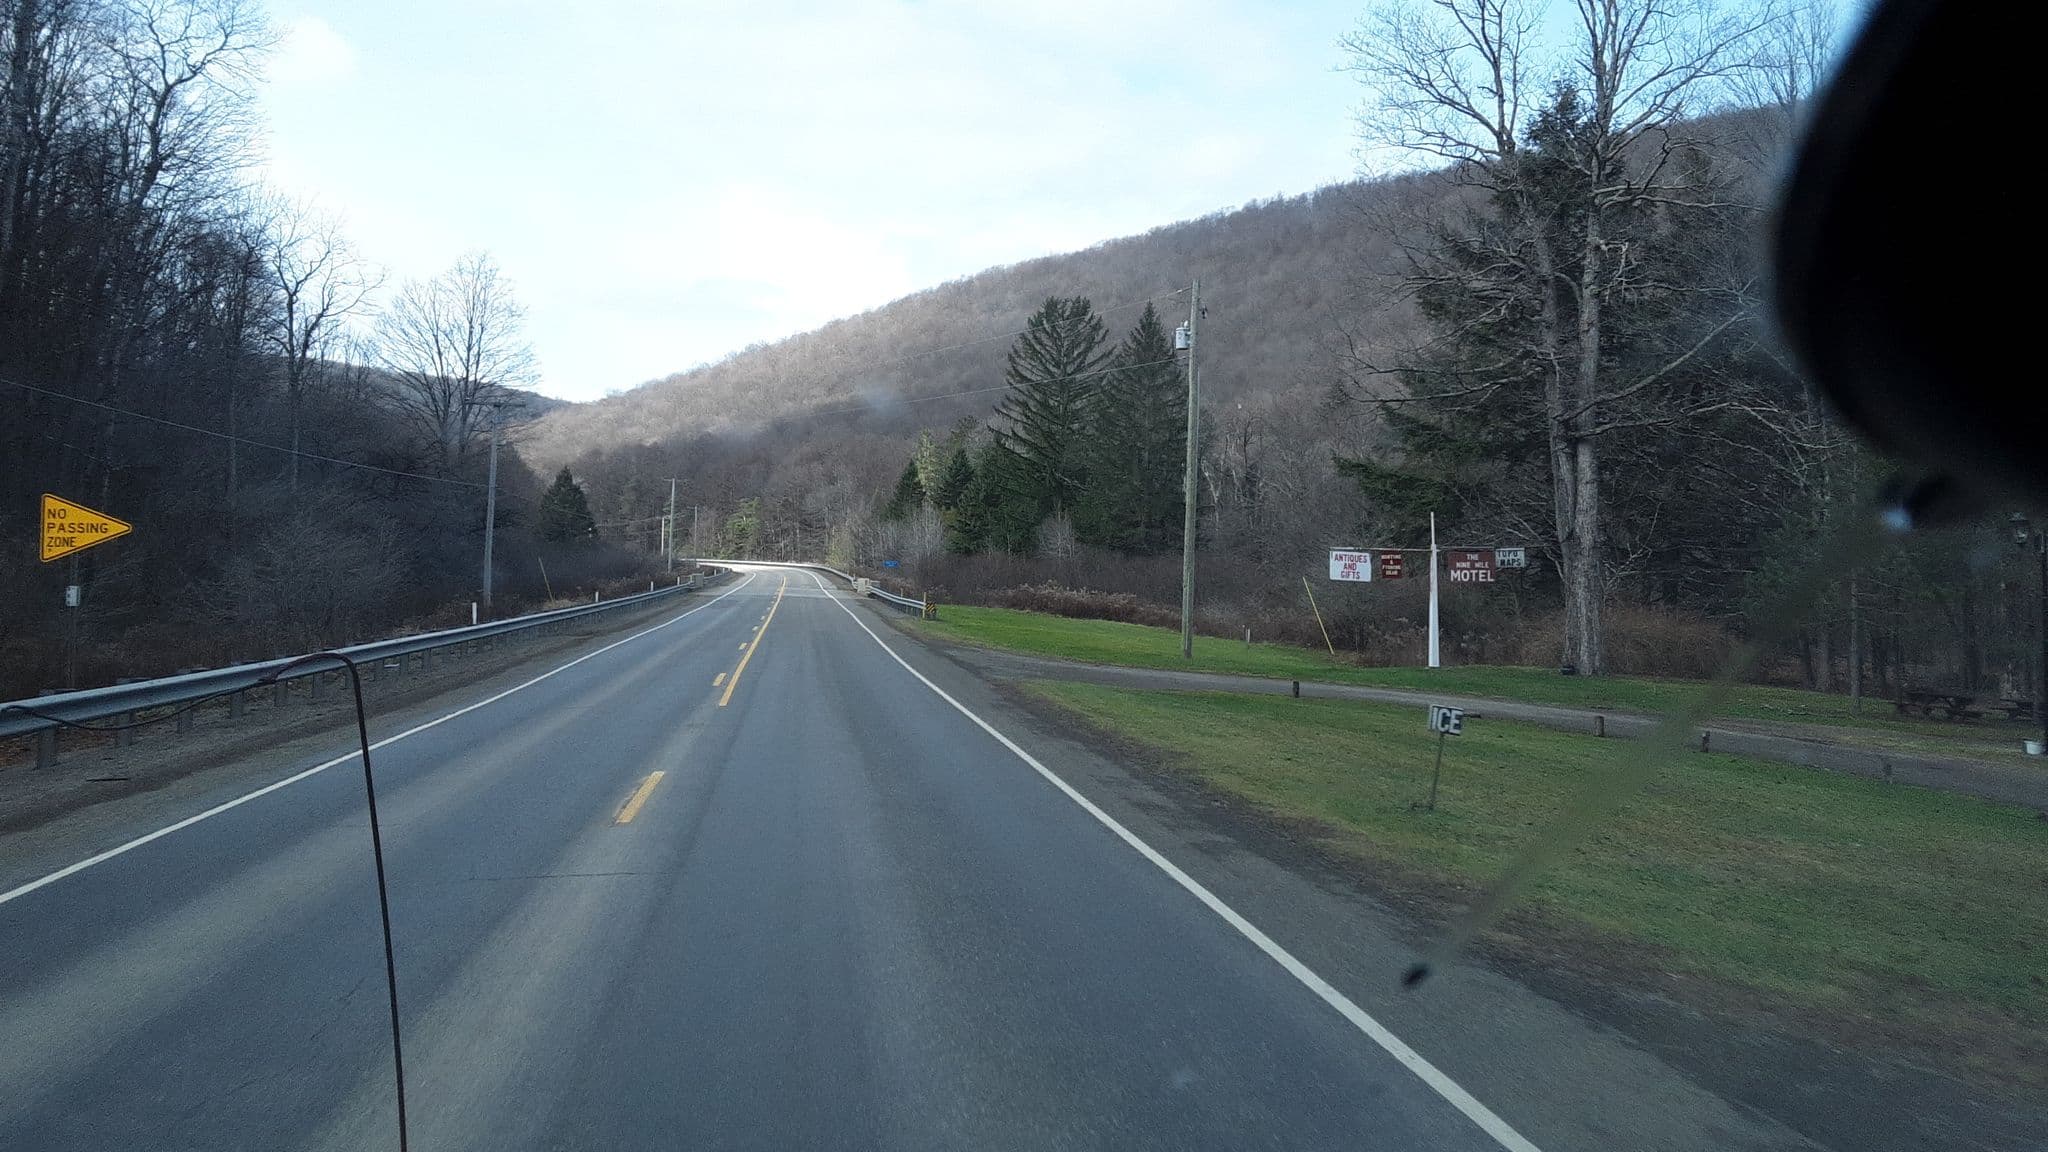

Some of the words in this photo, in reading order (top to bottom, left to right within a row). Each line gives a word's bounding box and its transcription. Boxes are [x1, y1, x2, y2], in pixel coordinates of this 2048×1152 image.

[47, 508, 67, 519] NO
[47, 522, 108, 534] PASSING
[47, 537, 76, 548] ZONE
[1334, 553, 1368, 563] ANTIQUES
[1466, 553, 1479, 561] THE
[1343, 563, 1357, 571] AND
[1500, 558, 1522, 567] MAPS
[1340, 571, 1361, 580] GIFTS
[1450, 569, 1495, 582] MOTEL
[1432, 707, 1464, 734] ICE
